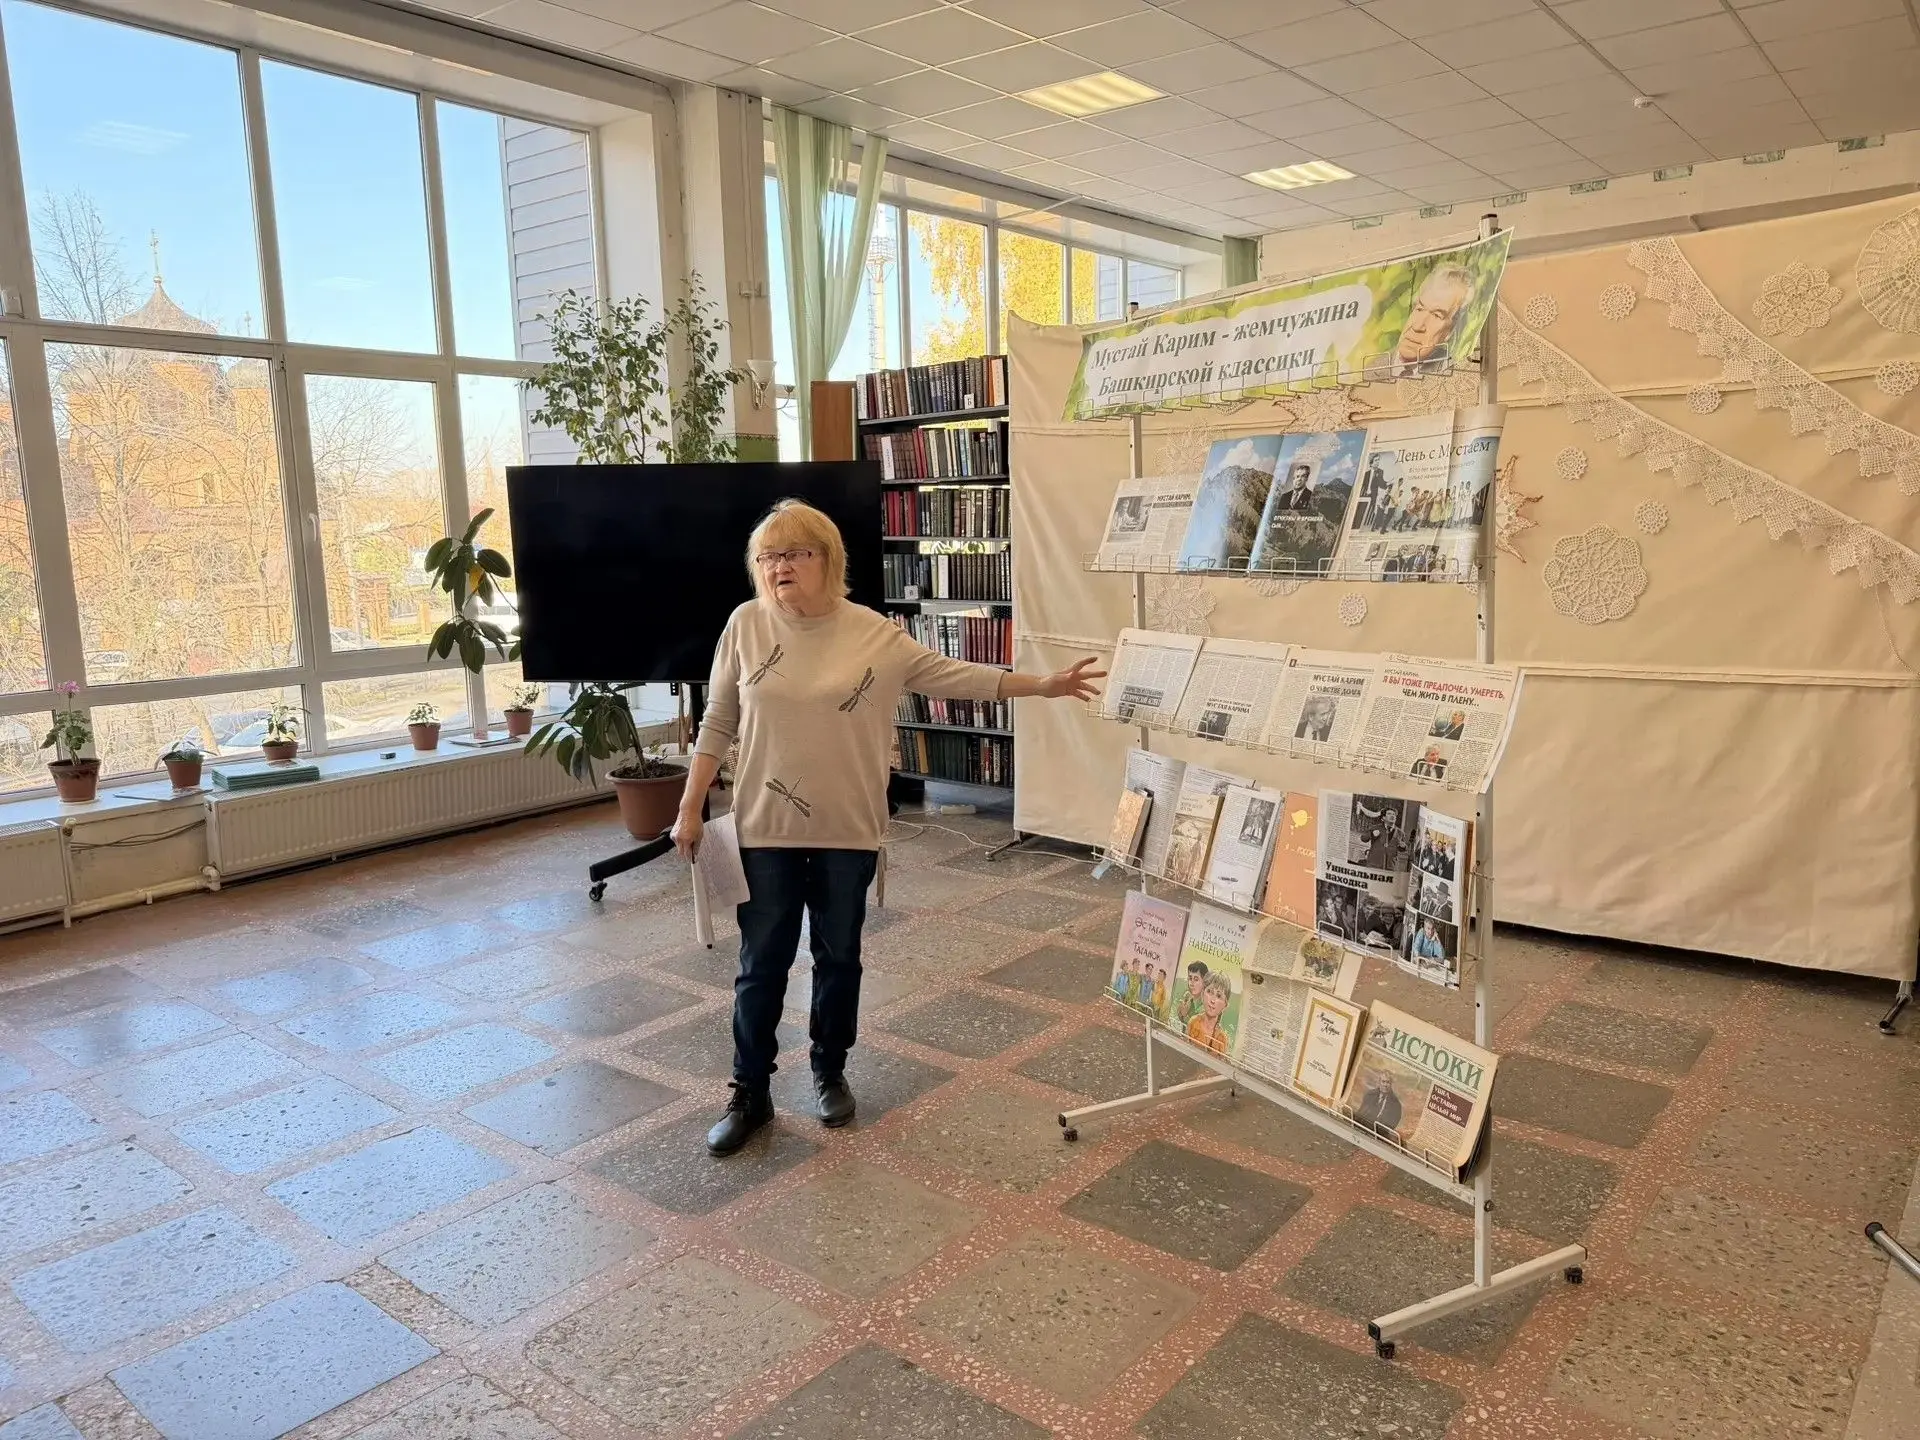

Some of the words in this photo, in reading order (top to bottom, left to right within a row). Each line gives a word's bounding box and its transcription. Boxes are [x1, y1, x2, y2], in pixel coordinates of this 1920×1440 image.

[1091, 336, 1149, 371] Мустай
[1152, 329, 1217, 358] Карим
[1233, 300, 1360, 342] жемчужина
[1098, 362, 1215, 397] Башкирской
[1218, 347, 1316, 382] классики
[1395, 449, 1426, 465] День
[1429, 448, 1436, 460] с
[1439, 441, 1491, 459] Мустаем
[1313, 674, 1340, 684] МУСТАЙ
[1340, 676, 1365, 686] КАРИМ
[1382, 675, 1388, 683] Я
[1388, 676, 1399, 685] БЫ
[1401, 678, 1422, 688] ТОЖЕ
[1423, 680, 1468, 694] ПРЕДПОЧЕЛ
[1402, 688, 1417, 698] ЧЕМ
[1416, 691, 1440, 701] ЖИТЬ
[1441, 694, 1447, 702] В
[1325, 861, 1394, 884] Уникальная
[1325, 872, 1369, 889] находка
[1189, 937, 1224, 958] НАШЕГО
[1202, 931, 1240, 953] РАДОСТЬ
[1389, 1027, 1485, 1091] ИСТОКИ
